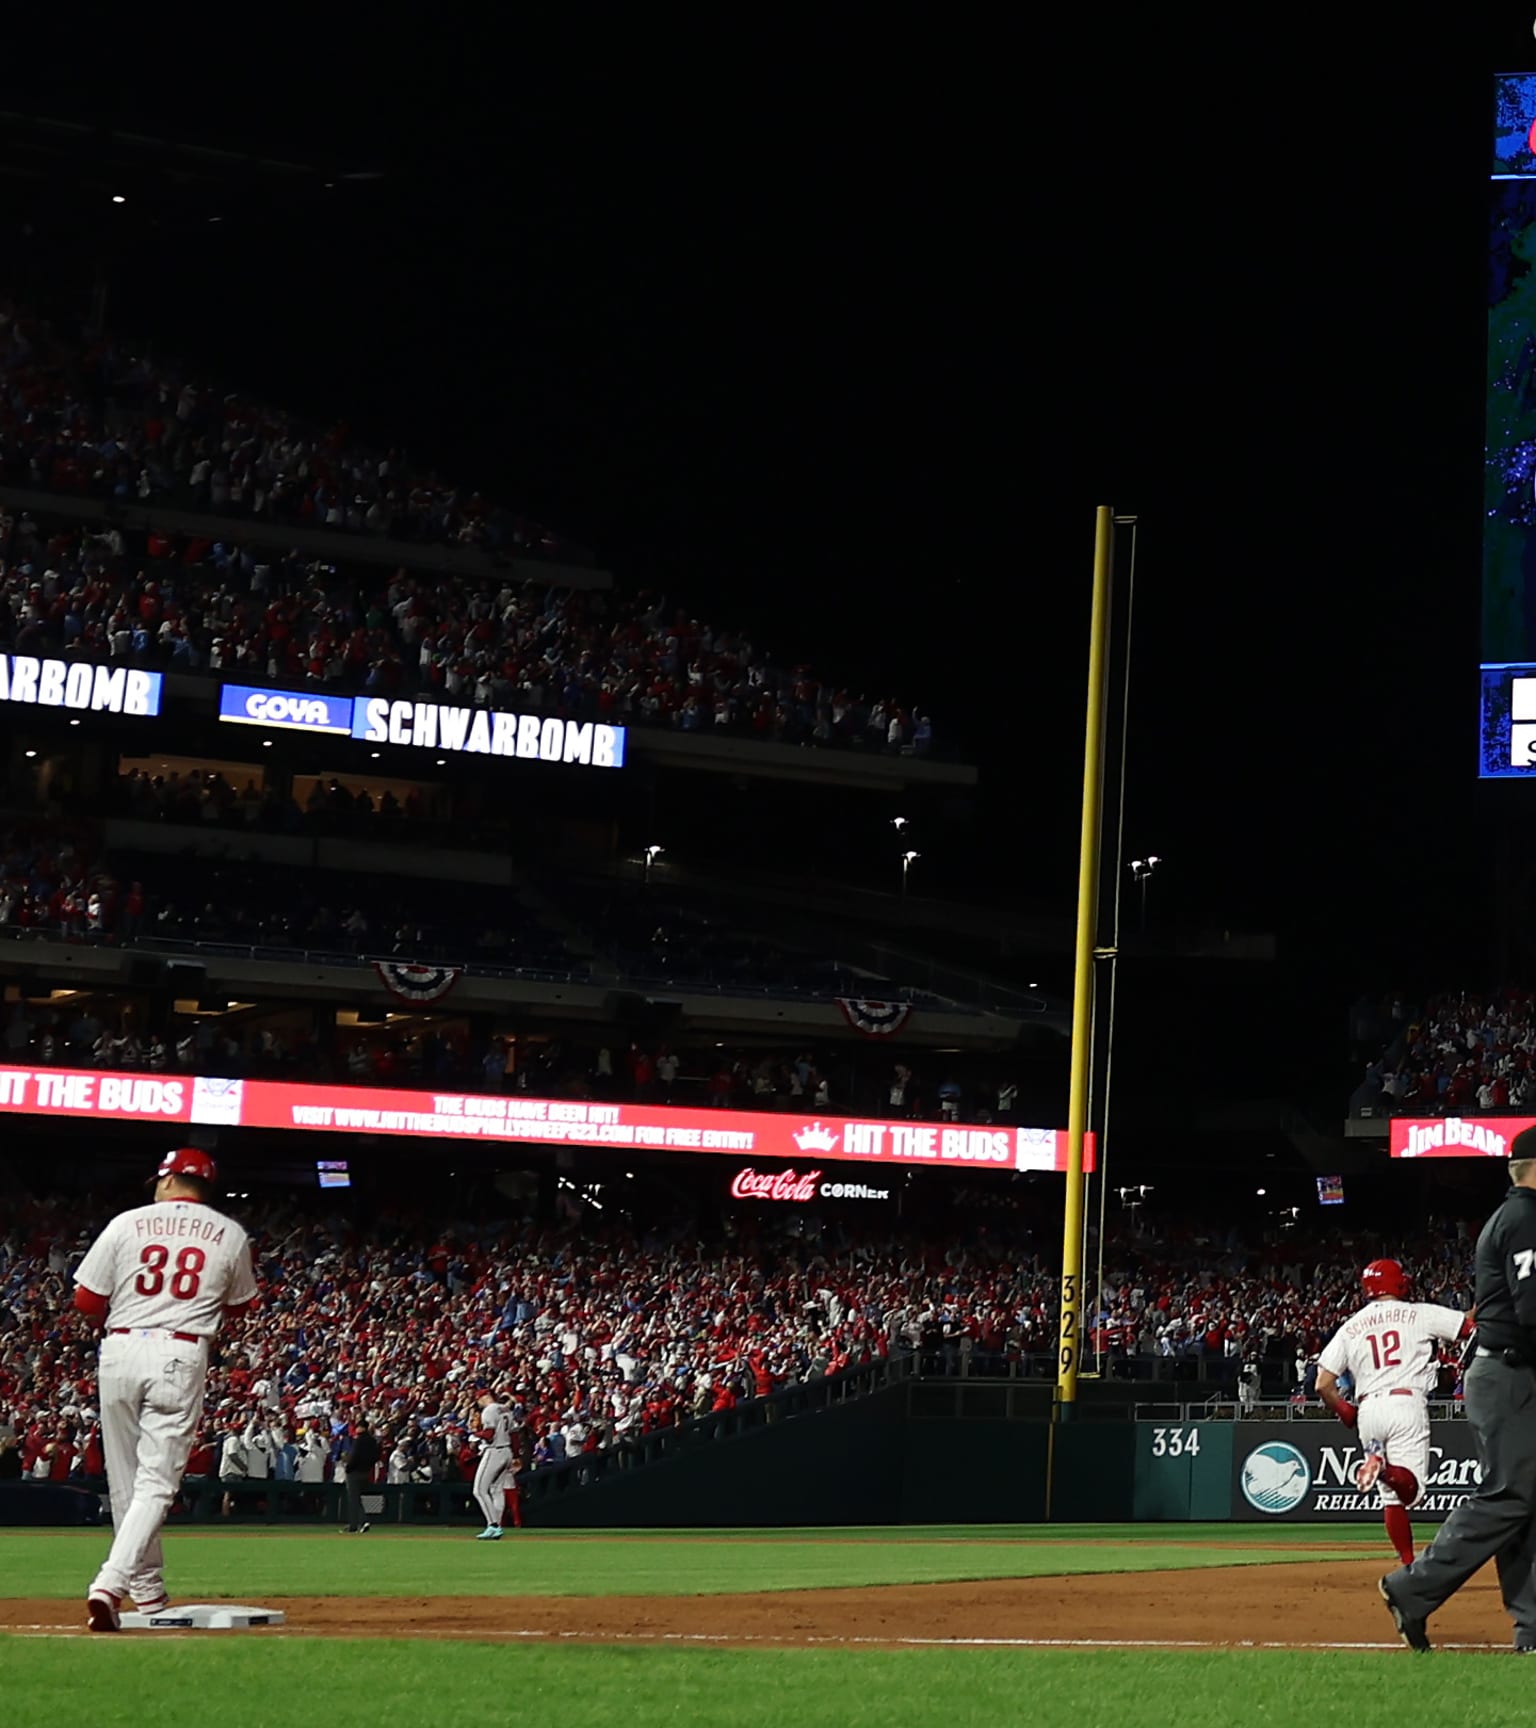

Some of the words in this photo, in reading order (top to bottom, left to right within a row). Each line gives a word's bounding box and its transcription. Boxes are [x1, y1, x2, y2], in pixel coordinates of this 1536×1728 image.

[245, 693, 329, 725] GOYA
[365, 698, 615, 767] SCHWARBOMB
[35, 1074, 94, 1108] THE
[100, 1077, 183, 1114] BUDS
[434, 1096, 463, 1114] THE
[507, 1101, 547, 1119] HAVE
[548, 1103, 587, 1122] BEEN
[292, 1106, 333, 1126] VISIT
[635, 1126, 665, 1144] FOR
[666, 1128, 702, 1147] FREE
[702, 1131, 754, 1150] ENTRY!
[843, 1123, 890, 1155] HIT
[891, 1126, 937, 1158] THE
[942, 1130, 1008, 1161] BUDS
[1401, 1125, 1443, 1157] JIM
[1444, 1117, 1507, 1156] BEAM
[135, 1217, 226, 1246] FIGUEROA
[135, 1244, 206, 1300] 38
[1060, 1275, 1076, 1374] 329
[1345, 1309, 1418, 1339] SCHWARBER
[1366, 1330, 1401, 1369] 12
[1153, 1428, 1200, 1456] 334
